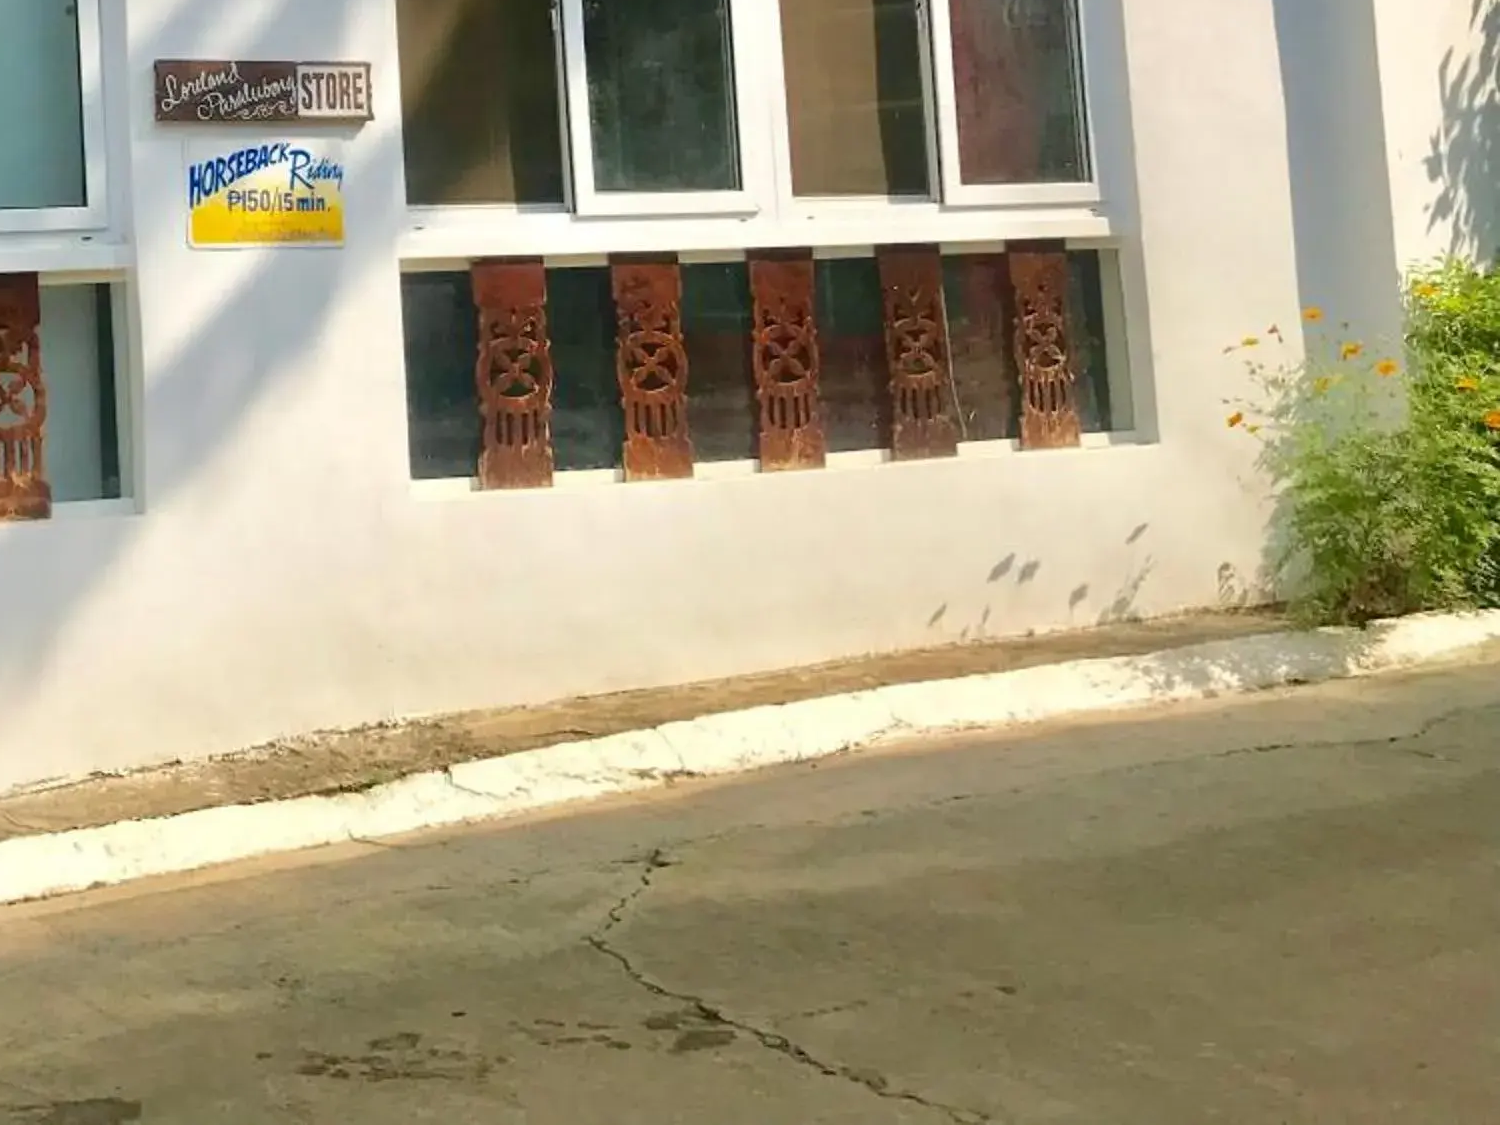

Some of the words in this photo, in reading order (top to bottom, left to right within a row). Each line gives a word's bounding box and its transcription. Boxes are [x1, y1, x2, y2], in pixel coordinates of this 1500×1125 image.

[161, 62, 245, 112] Loreland
[300, 71, 365, 111] STORE
[188, 142, 291, 210] HORSEBACK
[288, 148, 345, 191] Riding
